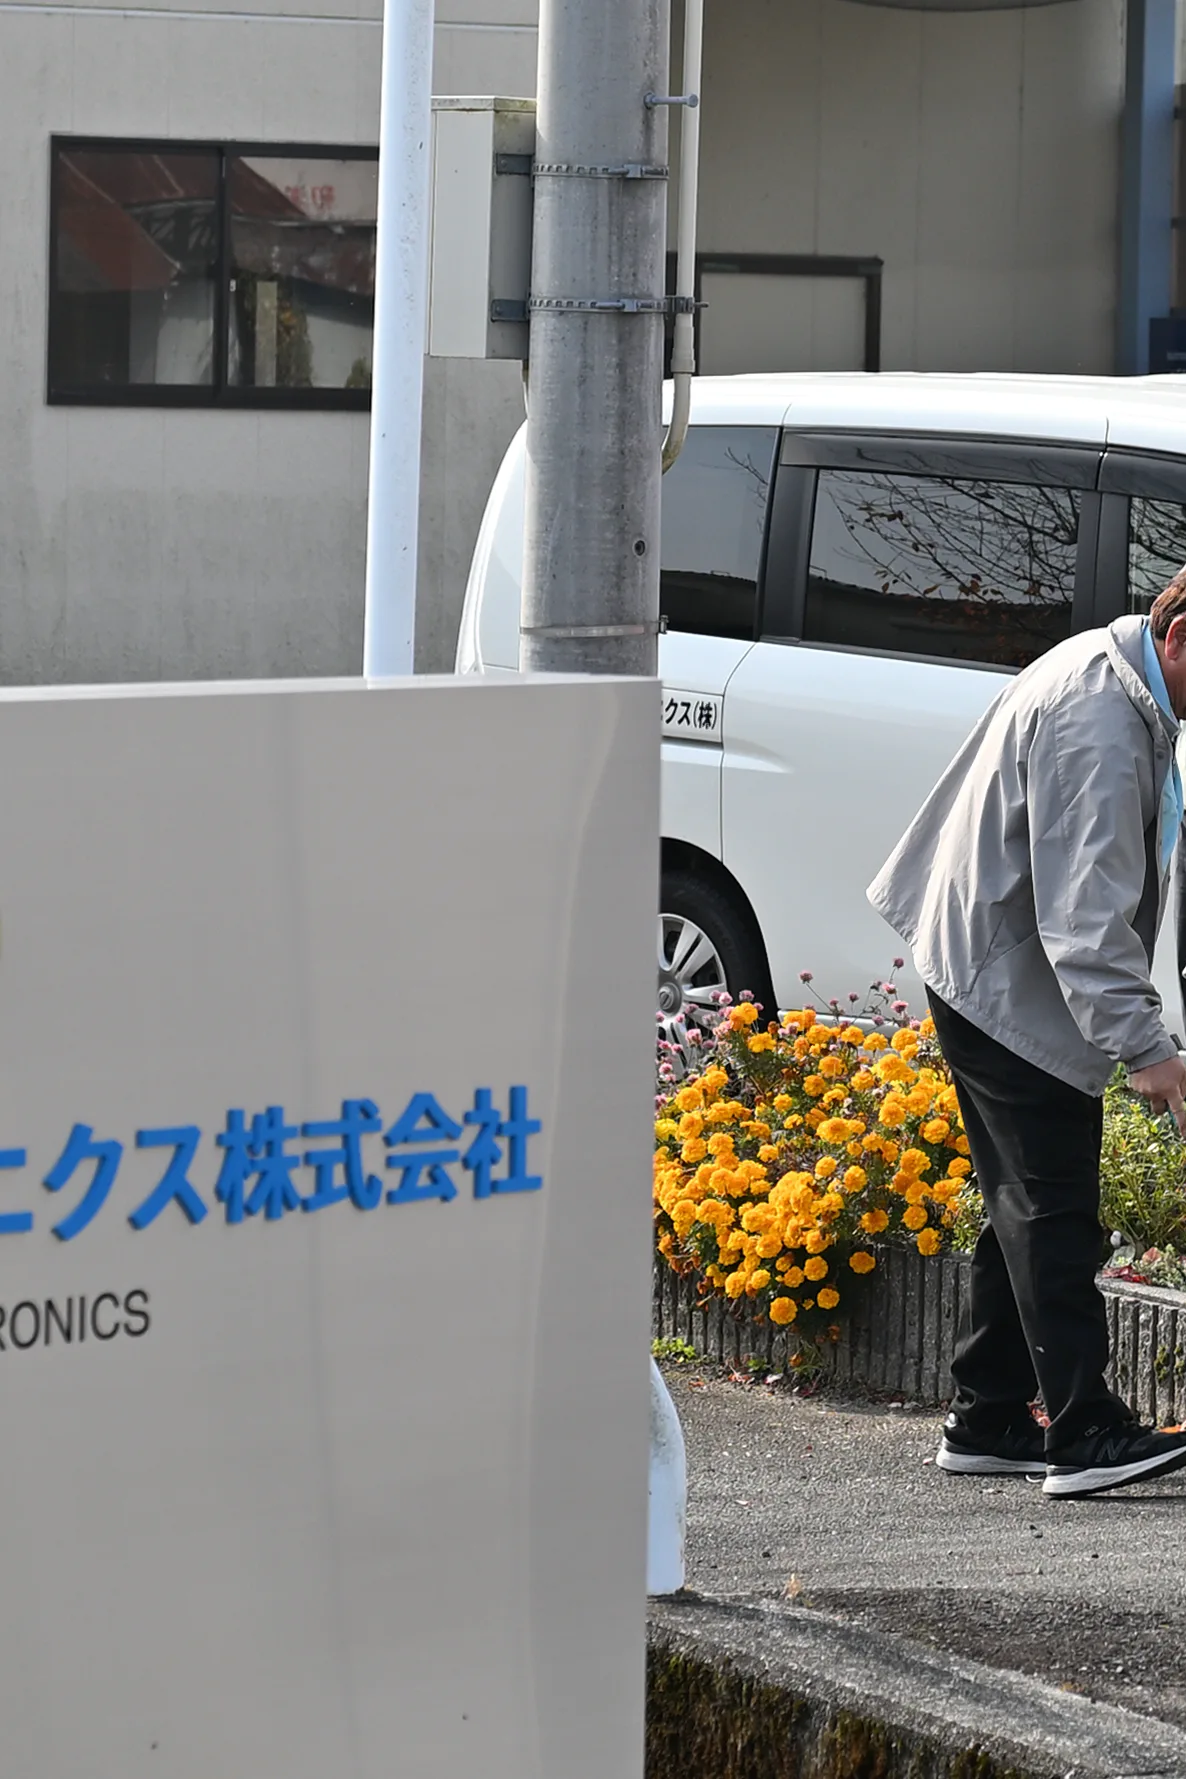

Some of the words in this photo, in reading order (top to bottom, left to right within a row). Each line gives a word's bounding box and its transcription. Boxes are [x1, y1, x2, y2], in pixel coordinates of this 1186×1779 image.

[661, 698, 717, 730] クス(株)
[0, 1289, 150, 1351] ONICS
